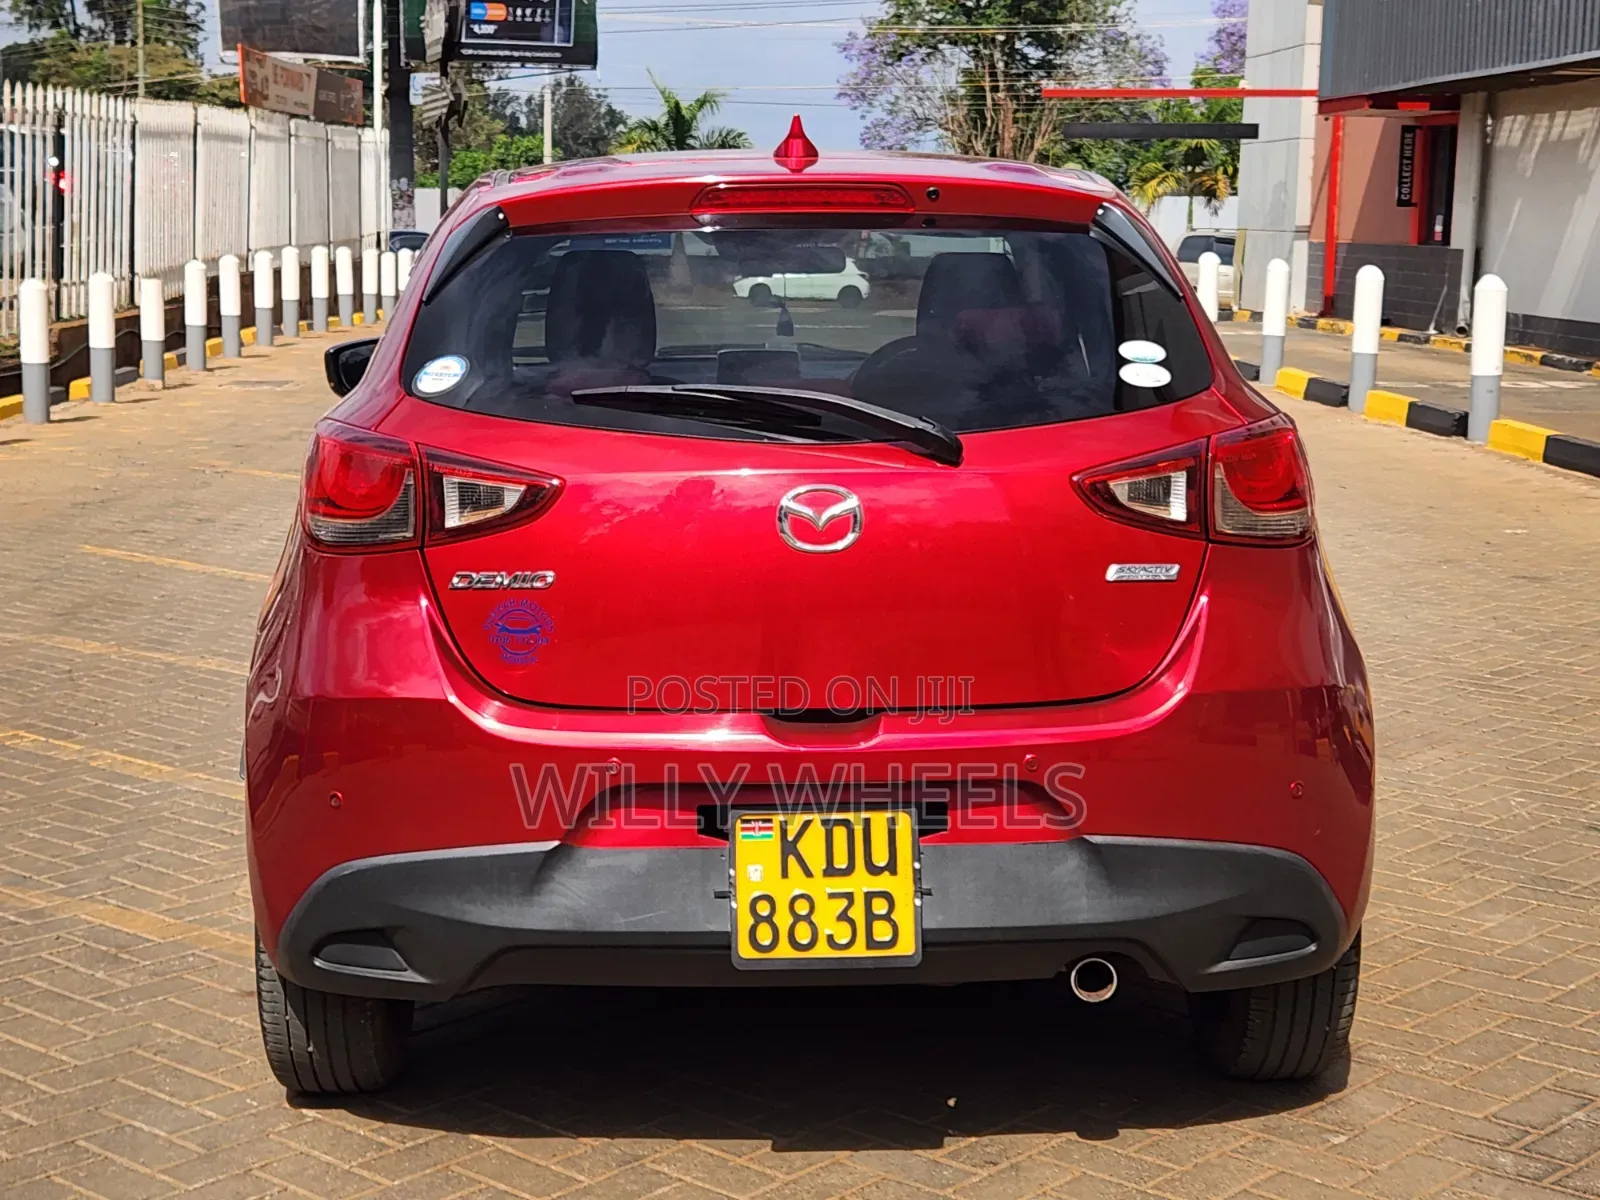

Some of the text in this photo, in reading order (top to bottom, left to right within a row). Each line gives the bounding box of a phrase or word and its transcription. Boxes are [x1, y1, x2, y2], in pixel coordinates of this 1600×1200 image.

[1400, 132, 1414, 200] COLLECT HERE
[448, 570, 555, 590] DEMIO
[779, 816, 898, 880] KDU
[748, 890, 899, 954] 883B
